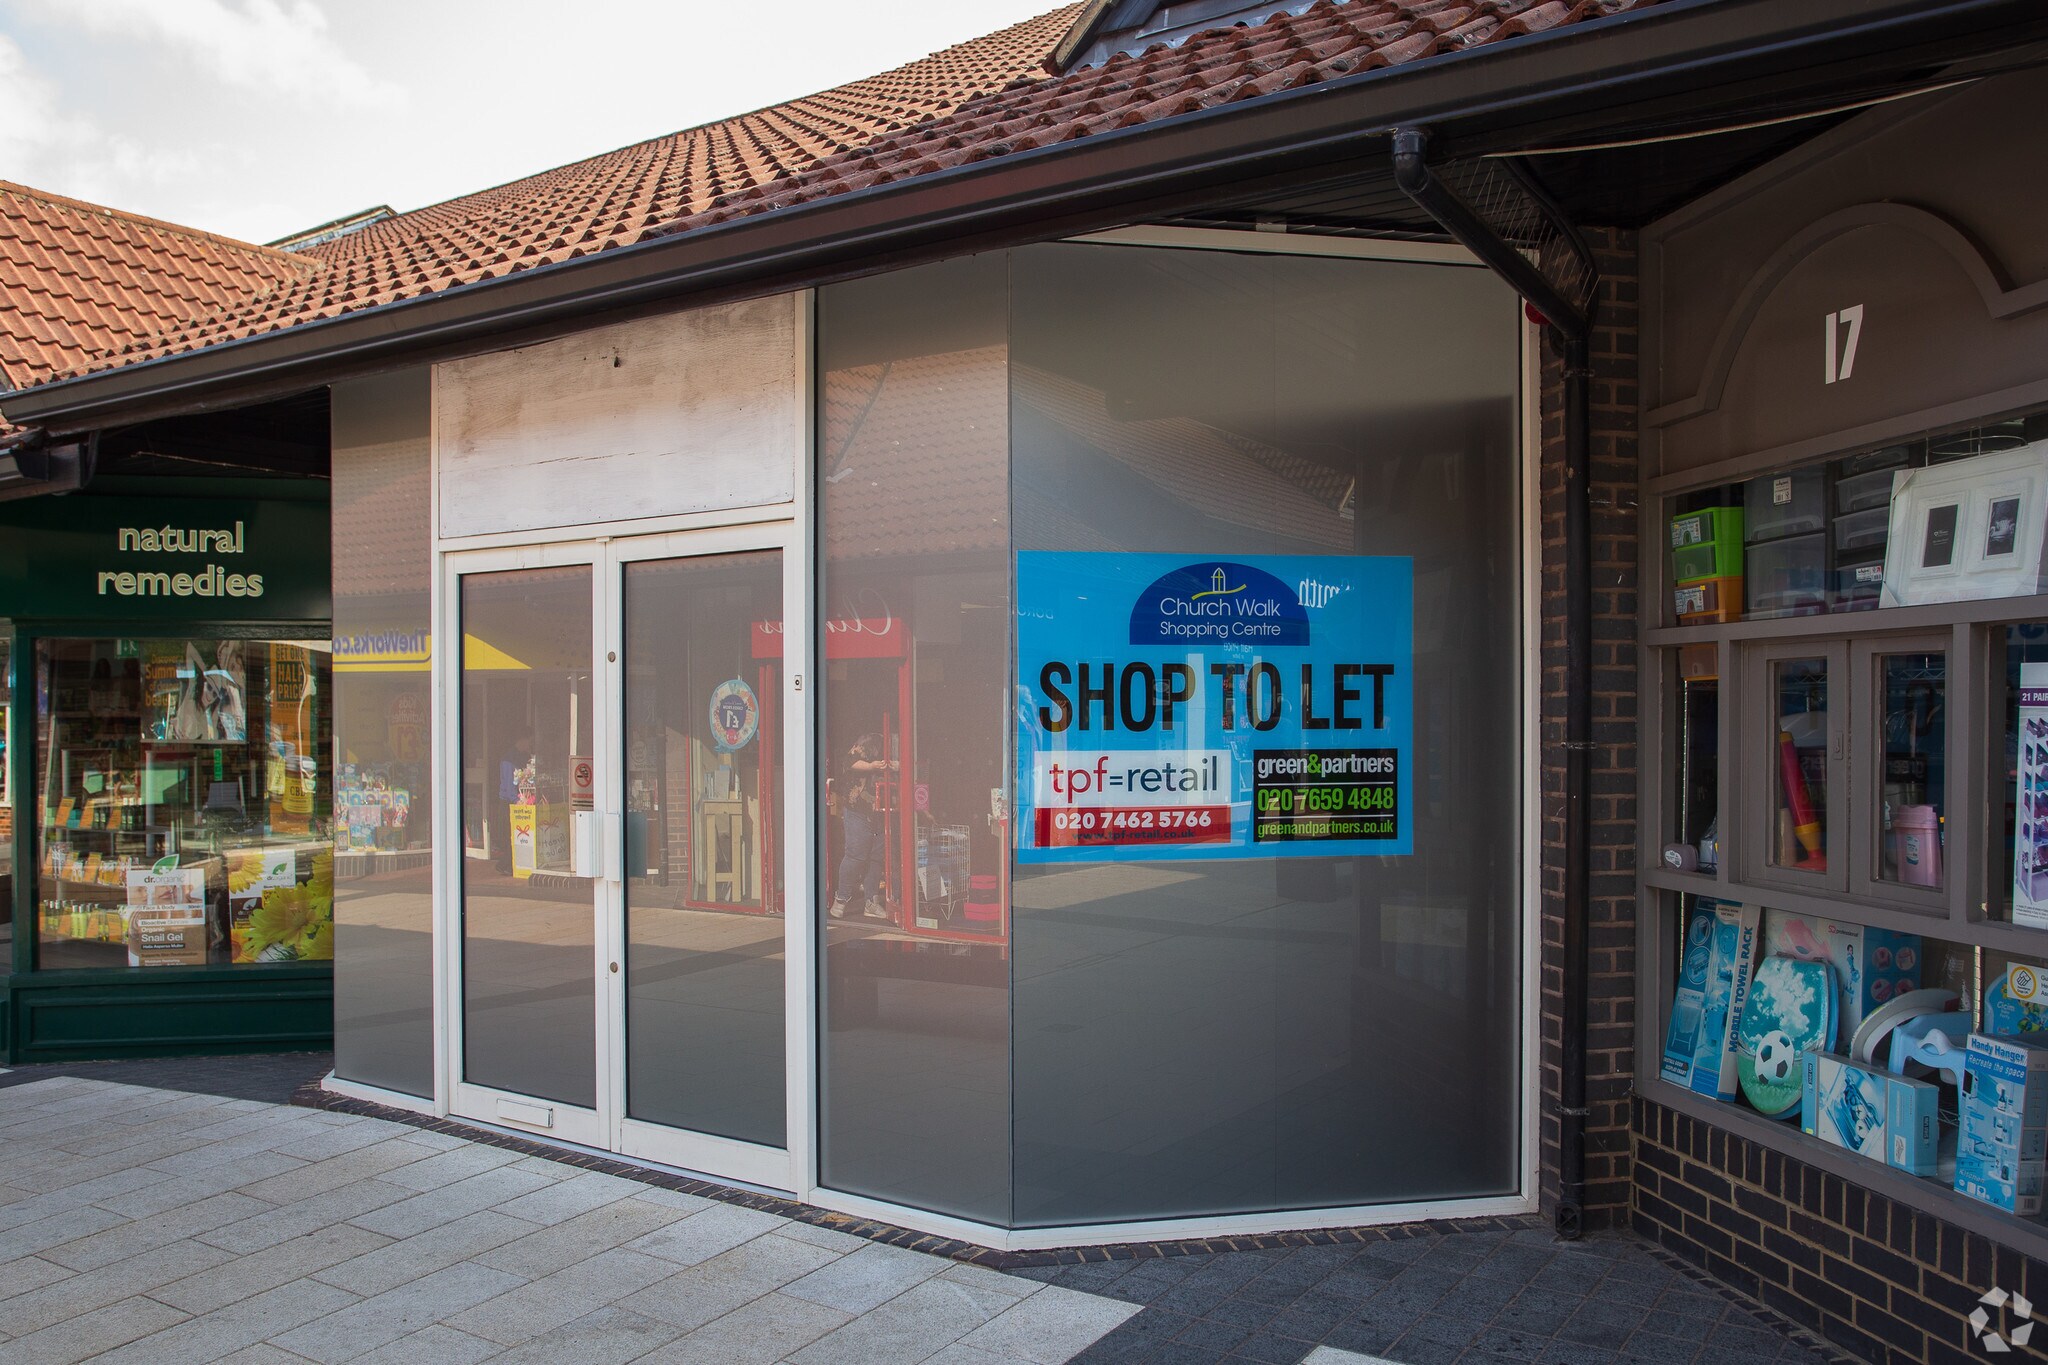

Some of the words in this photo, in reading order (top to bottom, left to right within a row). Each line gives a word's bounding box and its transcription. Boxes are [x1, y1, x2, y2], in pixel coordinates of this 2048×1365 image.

[1825, 304, 1863, 384] 17
[118, 521, 244, 553] natural
[97, 565, 264, 597] remedies
[1160, 597, 1231, 616] Church
[1235, 598, 1281, 616] Walk
[1160, 621, 1228, 638] Shopping
[1232, 621, 1281, 636] Centre
[277, 664, 304, 681] HALF
[1039, 661, 1196, 733] SHOP
[1211, 662, 1282, 731] TO
[1302, 663, 1395, 730] LET
[2022, 692, 2031, 701] 21
[1257, 754, 1394, 778] green&partners
[1049, 756, 1217, 803] tpf=retail
[1257, 788, 1293, 811] 020
[1297, 788, 1344, 811] 7659
[1347, 787, 1394, 810] 4848
[1055, 812, 1096, 829] 020
[1100, 811, 1154, 828] 7462
[1158, 810, 1212, 828] 5766
[1257, 820, 1394, 838] greenandpartners.co.uk
[1072, 828, 1195, 841] www.tpf-retail.co.uk
[141, 933, 165, 942] Snail
[167, 933, 183, 941] Gel
[1741, 926, 1754, 959] RACK
[1836, 929, 1858, 938] professional
[1735, 962, 1749, 1004] TOWEL
[1728, 1006, 1743, 1053] MOBILE
[1971, 1038, 1993, 1055] Handy
[1994, 1045, 2025, 1062] Hanger
[1968, 1054, 1992, 1069] Recreate
[1993, 1061, 2003, 1072] the
[2005, 1066, 2025, 1079] space
